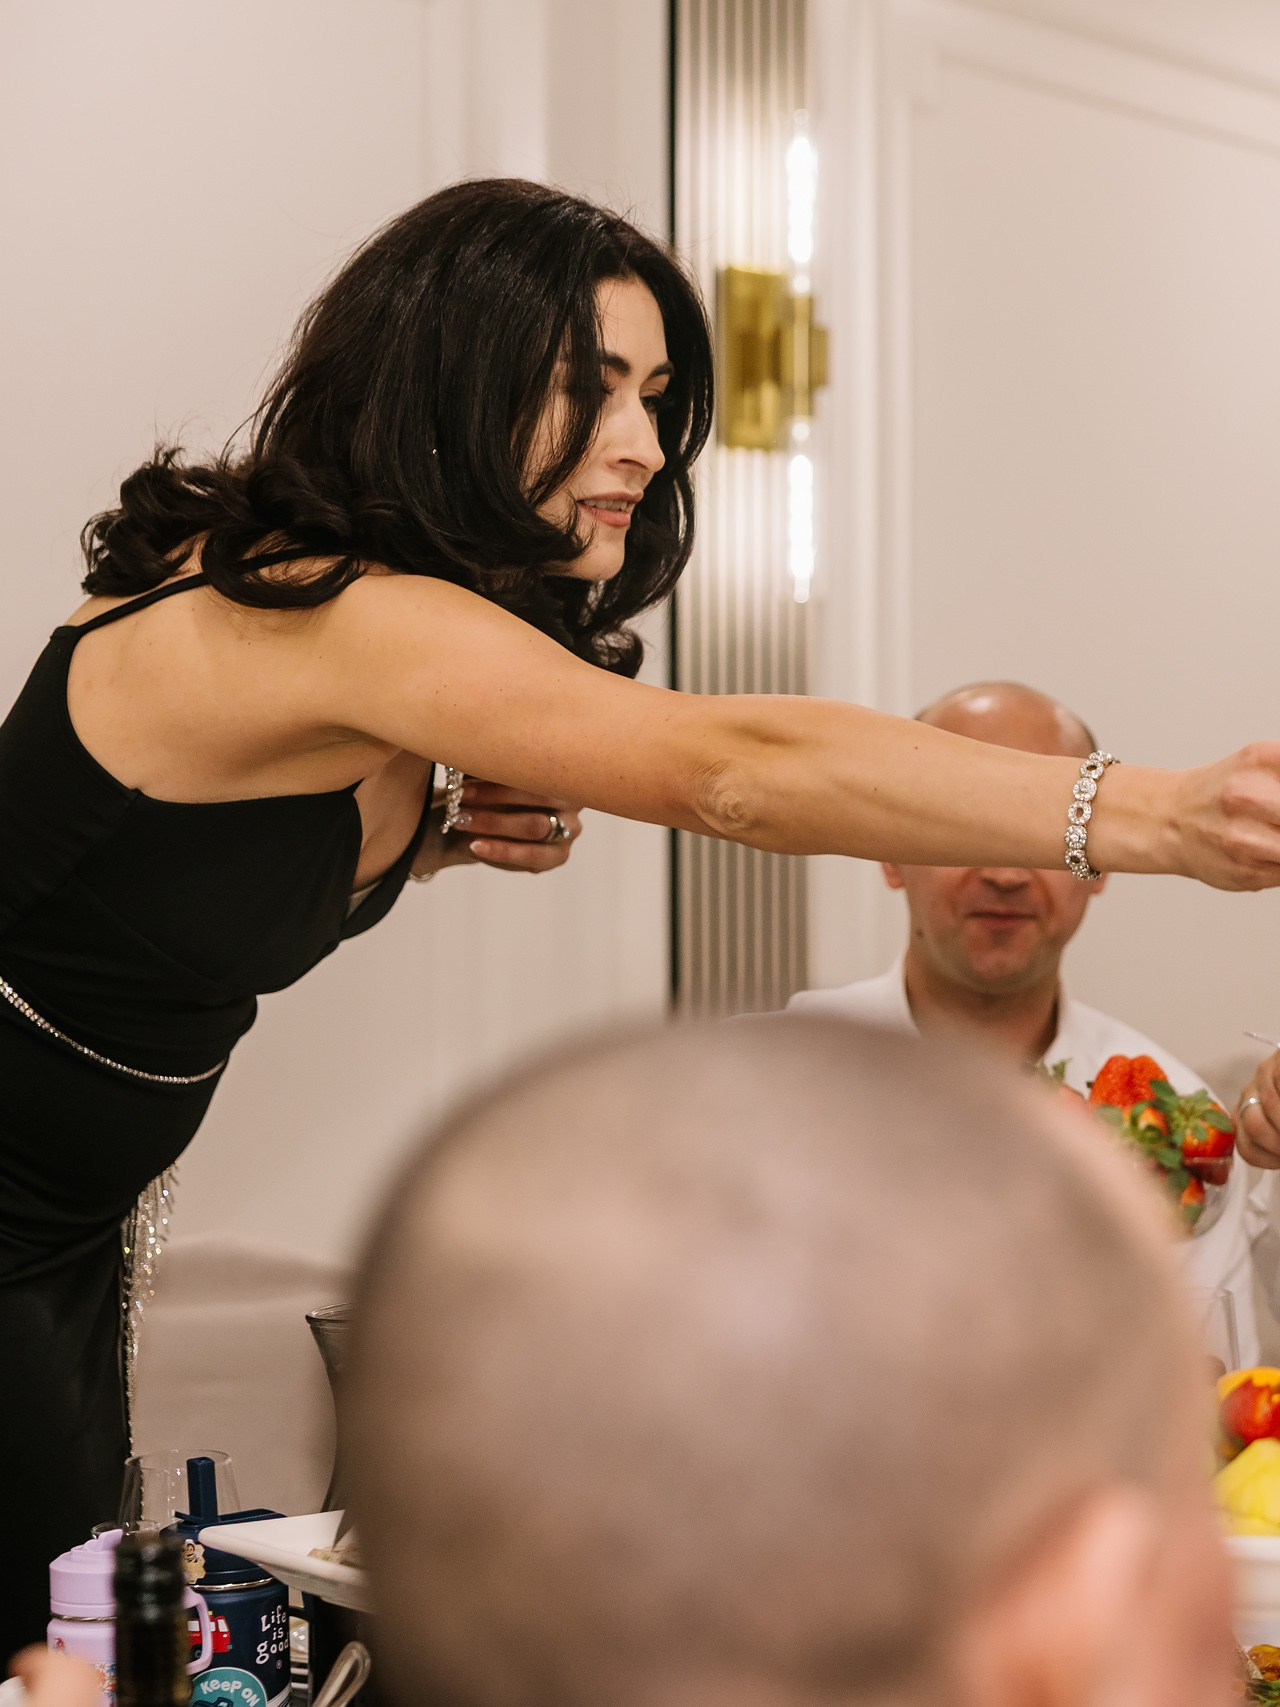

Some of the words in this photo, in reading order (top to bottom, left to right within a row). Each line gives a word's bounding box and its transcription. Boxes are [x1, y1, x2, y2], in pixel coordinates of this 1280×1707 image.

[261, 1605, 287, 1632] Life
[272, 1627, 284, 1640] is
[255, 1640, 289, 1664] good
